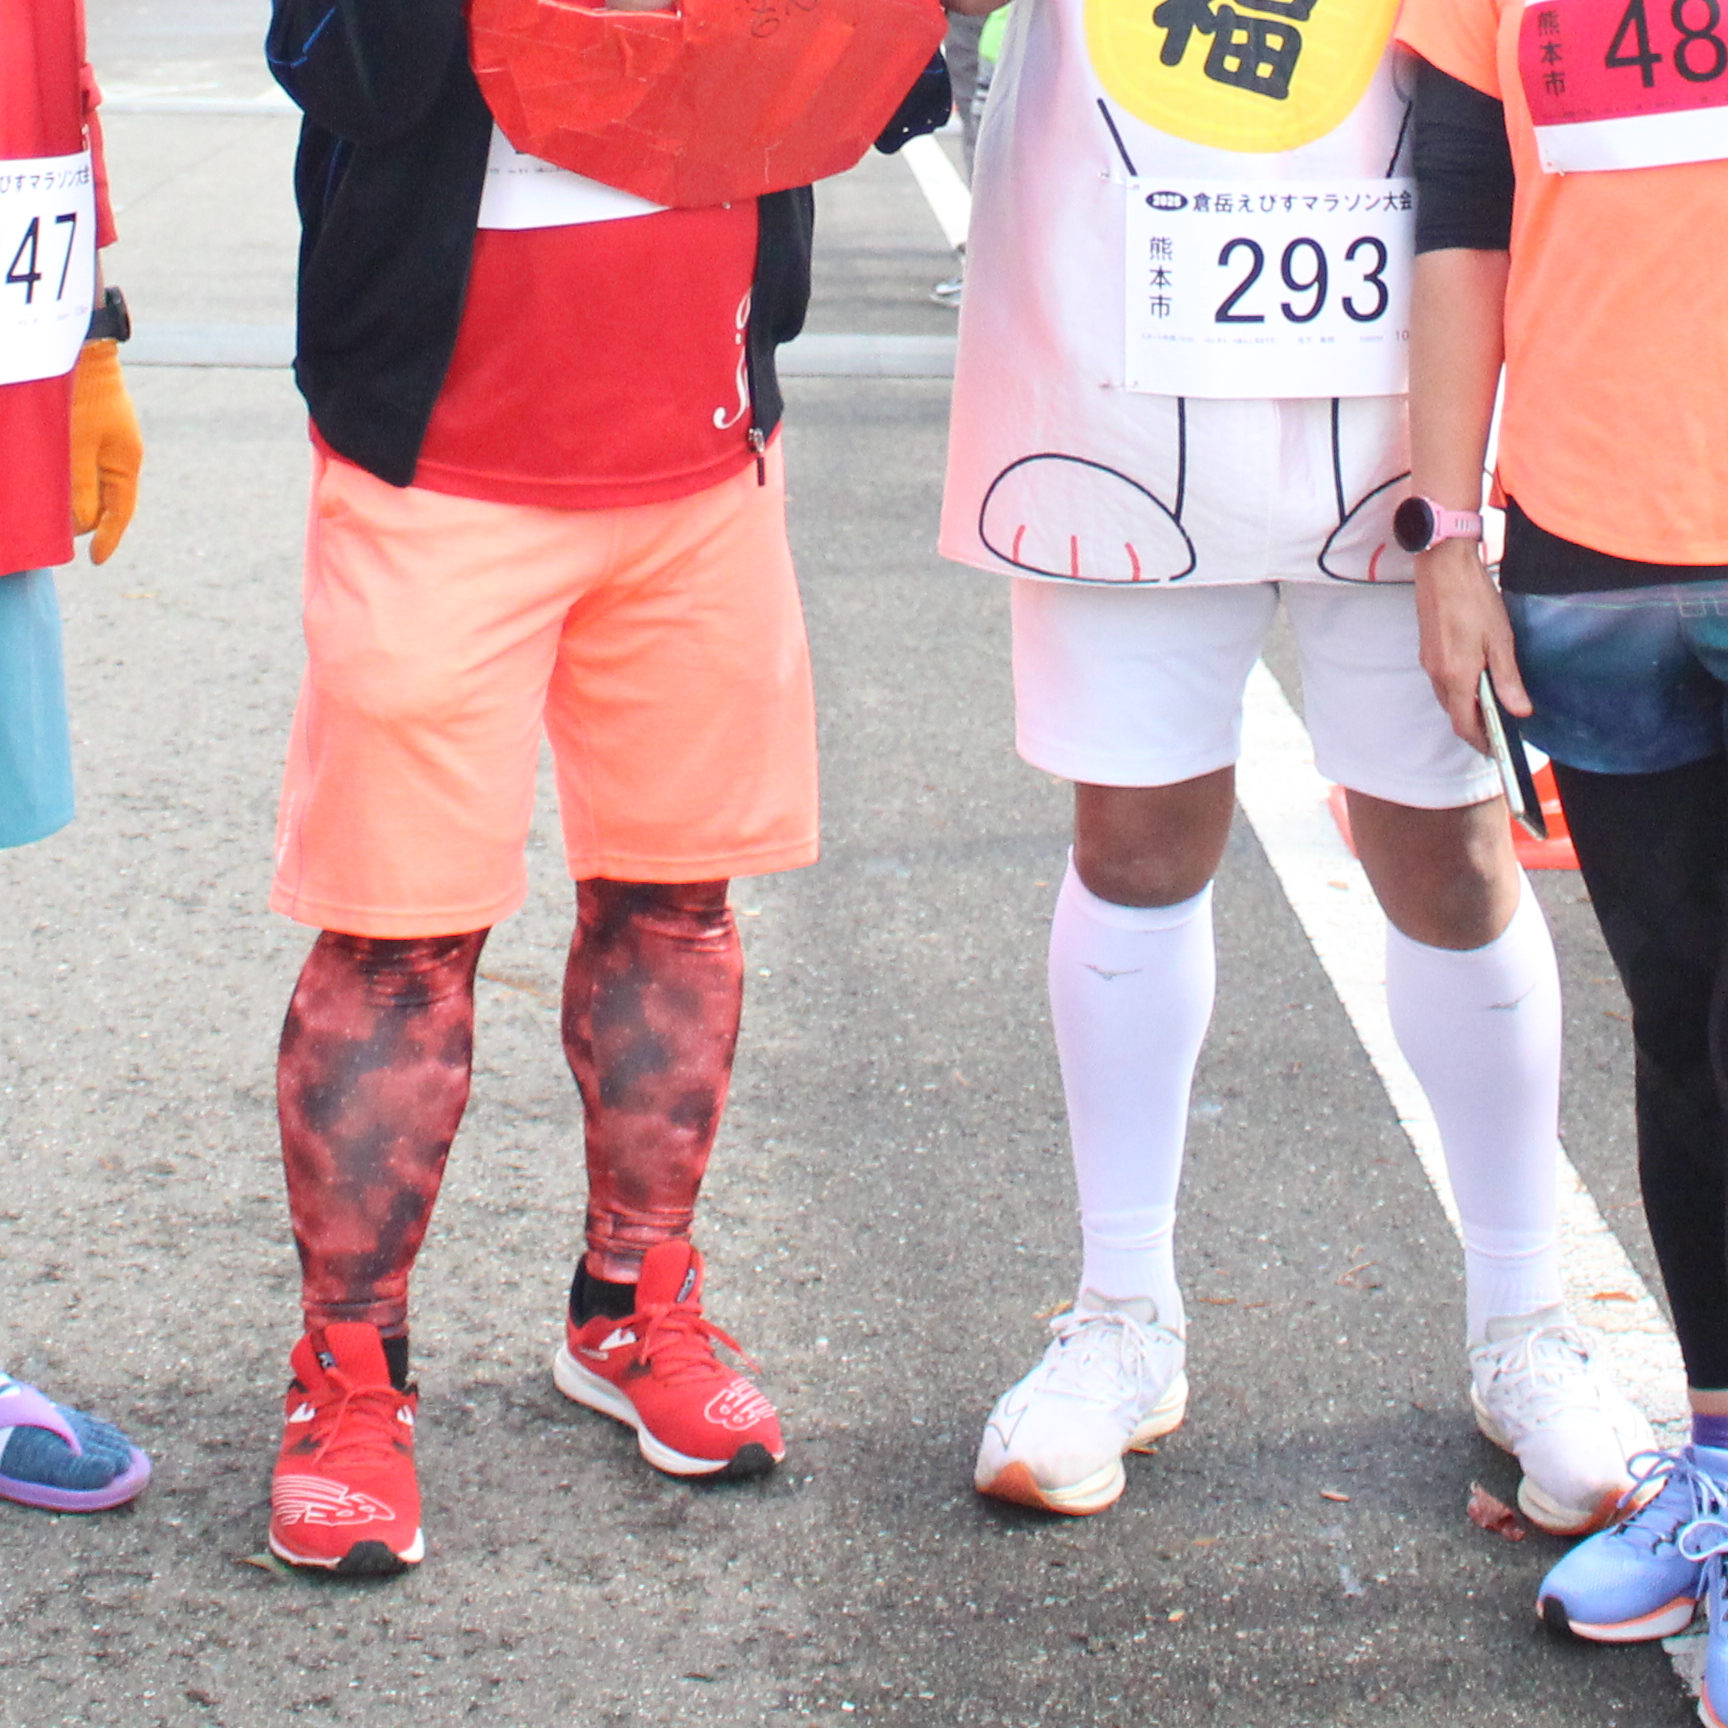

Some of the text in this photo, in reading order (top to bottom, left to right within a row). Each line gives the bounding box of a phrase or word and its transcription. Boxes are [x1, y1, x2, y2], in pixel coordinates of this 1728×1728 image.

[1536, 10, 1566, 98] 熊本市
[1193, 190, 1413, 214] 倉岳えびすマラソン大会
[1148, 235, 1173, 320] 熊本市
[1214, 235, 1390, 324] 293
